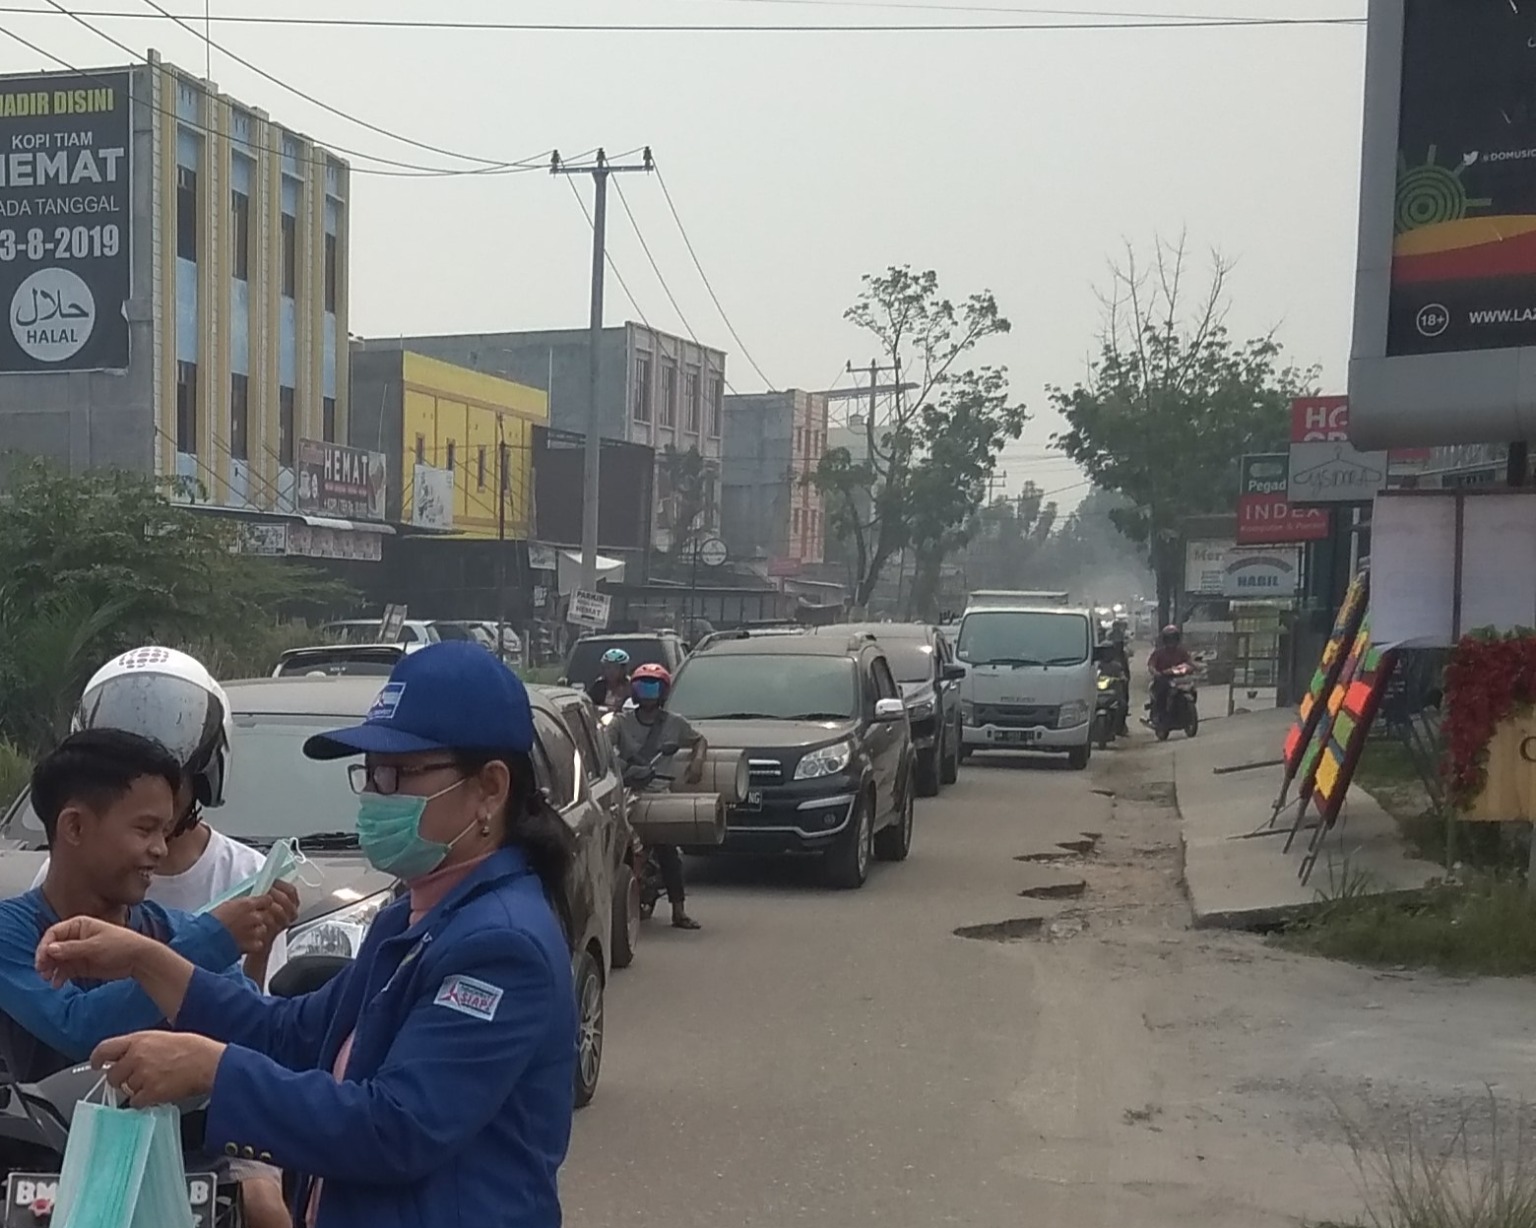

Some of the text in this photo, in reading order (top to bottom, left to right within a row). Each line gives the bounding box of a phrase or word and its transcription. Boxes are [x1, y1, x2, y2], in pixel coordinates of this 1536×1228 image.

[54, 88, 115, 115] DISINI
[11, 131, 94, 148] KOPI TIAM
[34, 196, 120, 215] TANGGAL
[15, 287, 90, 327] حلال
[1420, 314, 1445, 326] 18+
[26, 329, 79, 344] HALAL
[324, 448, 368, 486] HEMAT
[576, 590, 605, 604] PARKIR
[575, 605, 603, 618] HEMAT
